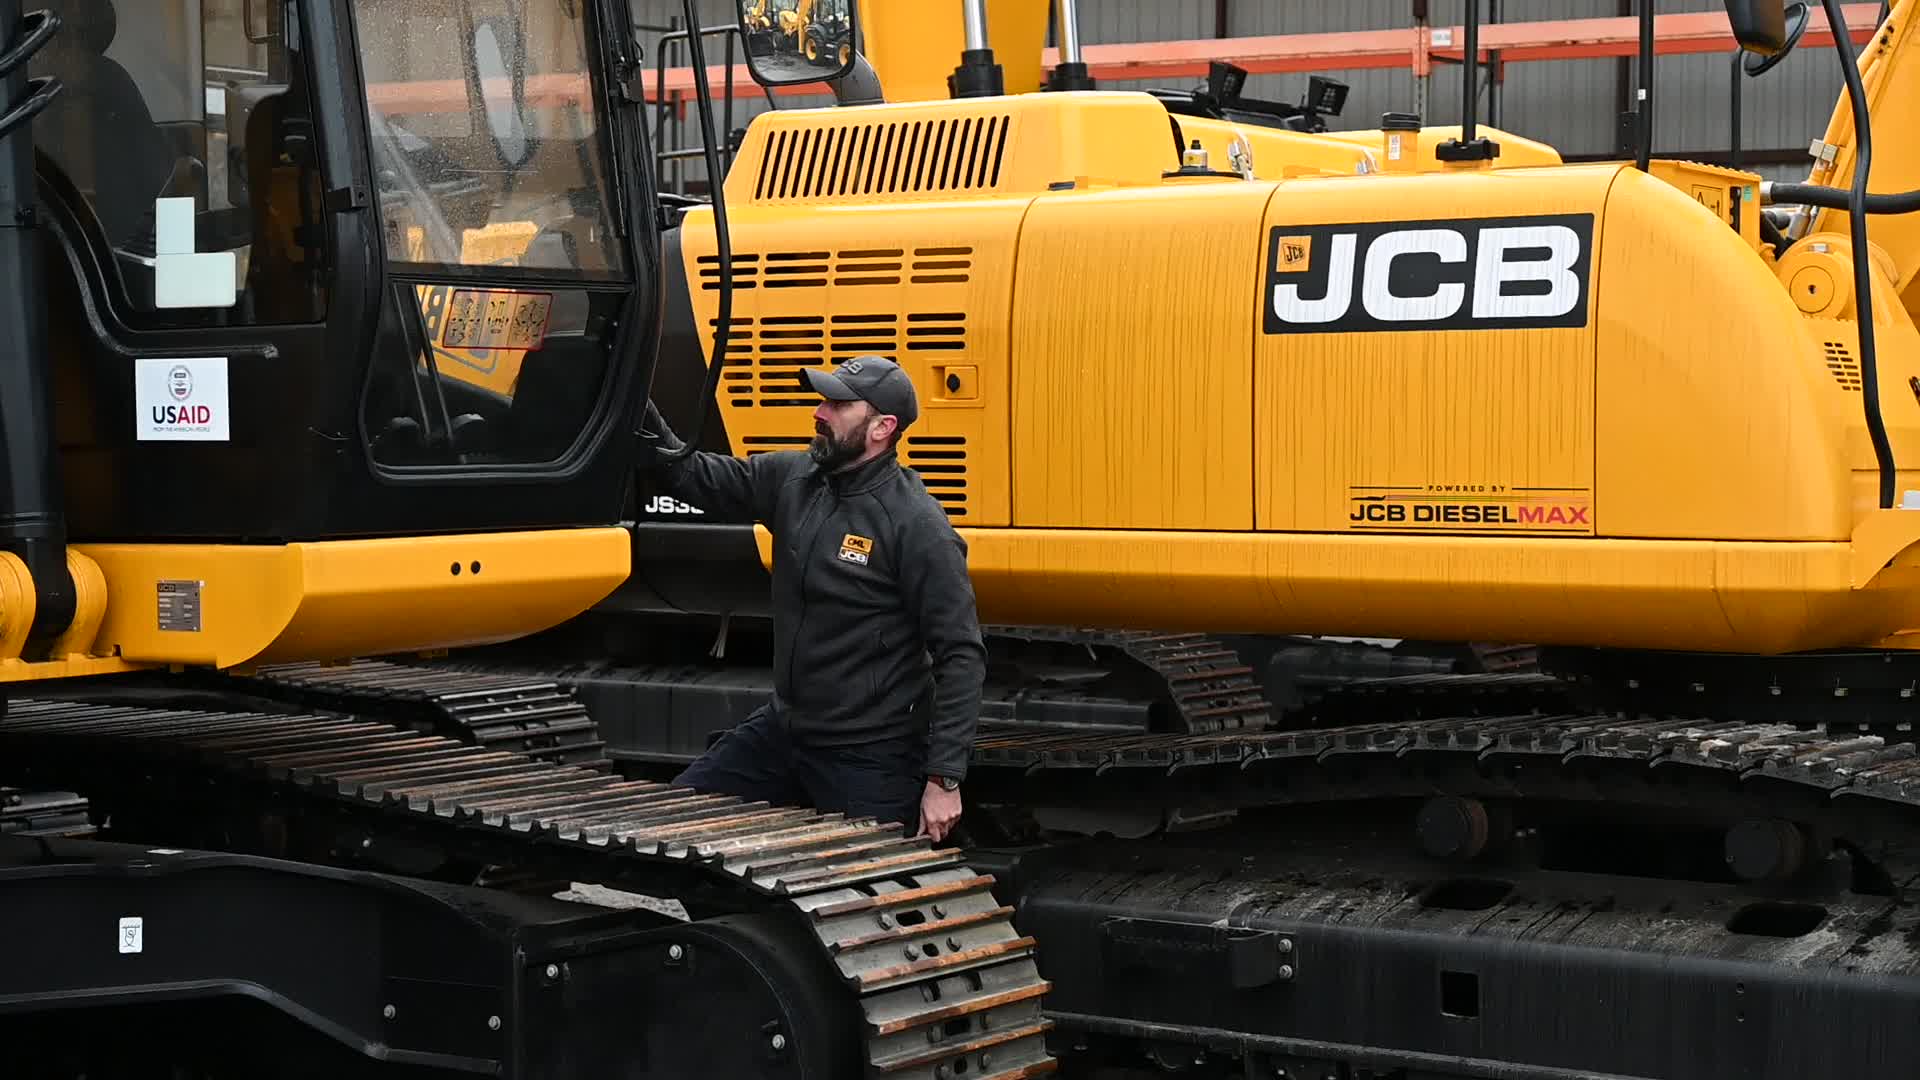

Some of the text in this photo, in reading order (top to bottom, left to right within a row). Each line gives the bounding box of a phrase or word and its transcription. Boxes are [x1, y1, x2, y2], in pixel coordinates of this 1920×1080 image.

[1286, 245, 1304, 262] JCB
[1273, 225, 1580, 324] JCB
[152, 405, 211, 424] USAID
[1350, 504, 1406, 521] JCB
[839, 547, 867, 563] JCB
